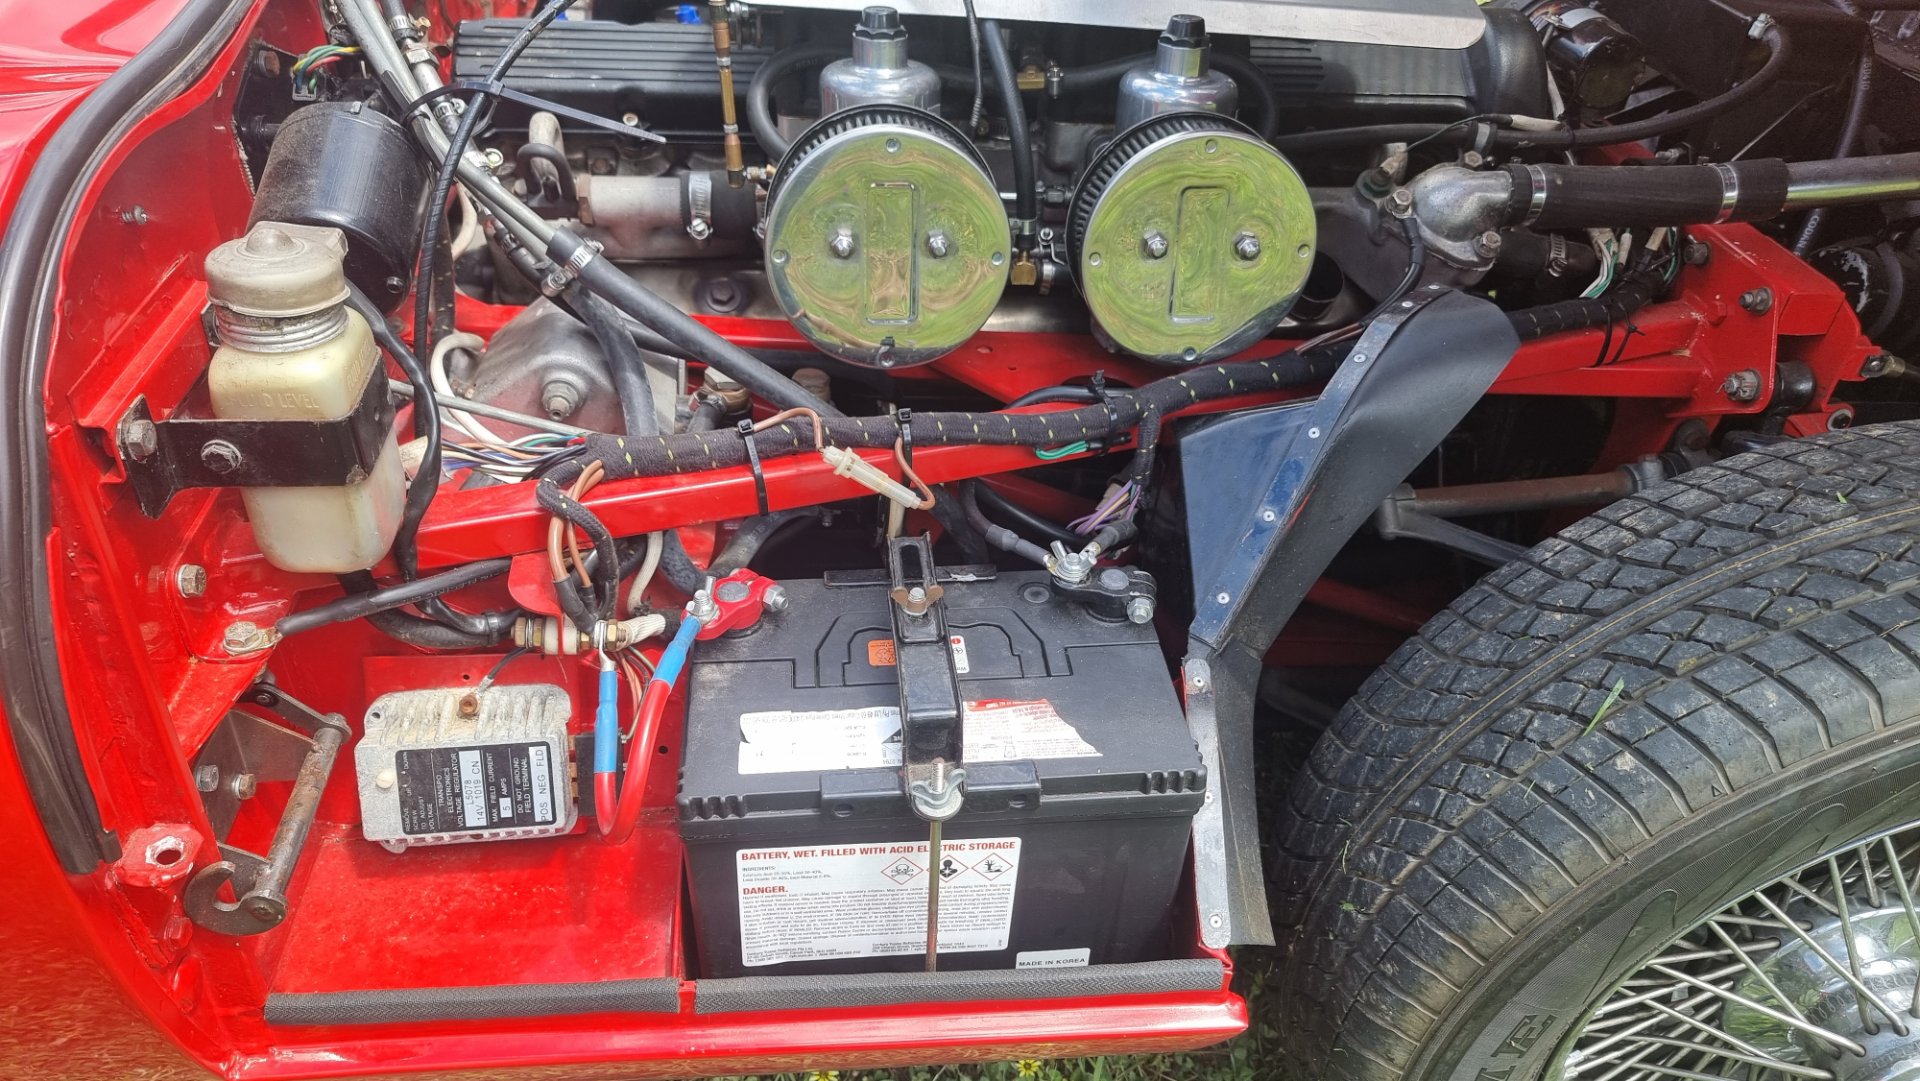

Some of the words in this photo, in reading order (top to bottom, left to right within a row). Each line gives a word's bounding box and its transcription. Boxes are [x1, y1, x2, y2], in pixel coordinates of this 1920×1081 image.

[278, 392, 320, 409] LEVEL
[472, 760, 481, 775] CN
[486, 752, 495, 783] CURRENT
[535, 749, 545, 767] FLD
[450, 752, 460, 793] REGULATOR
[513, 757, 521, 785] GROUND
[521, 757, 530, 791] TERMINAL
[436, 774, 446, 807] TRANSPO
[444, 767, 454, 813] ELECTRONICS
[464, 780, 474, 806] L5078
[500, 777, 508, 796] AMPS
[537, 774, 547, 795] NEG
[455, 797, 464, 828] VOLTAGE
[476, 804, 485, 821] 14V
[517, 803, 524, 814] DO
[523, 793, 532, 813] FIELD
[540, 801, 549, 821] POS
[421, 822, 427, 830] TO
[427, 803, 435, 831] VOLTAGE
[741, 850, 791, 861] BATTERY,
[793, 849, 818, 858] WET.
[821, 847, 856, 857] FILLED
[859, 845, 886, 855] WITH
[889, 845, 914, 854] ACID
[917, 842, 966, 853] ELTRIC
[968, 841, 1016, 851] STORAGE
[743, 885, 789, 895] DANGER.
